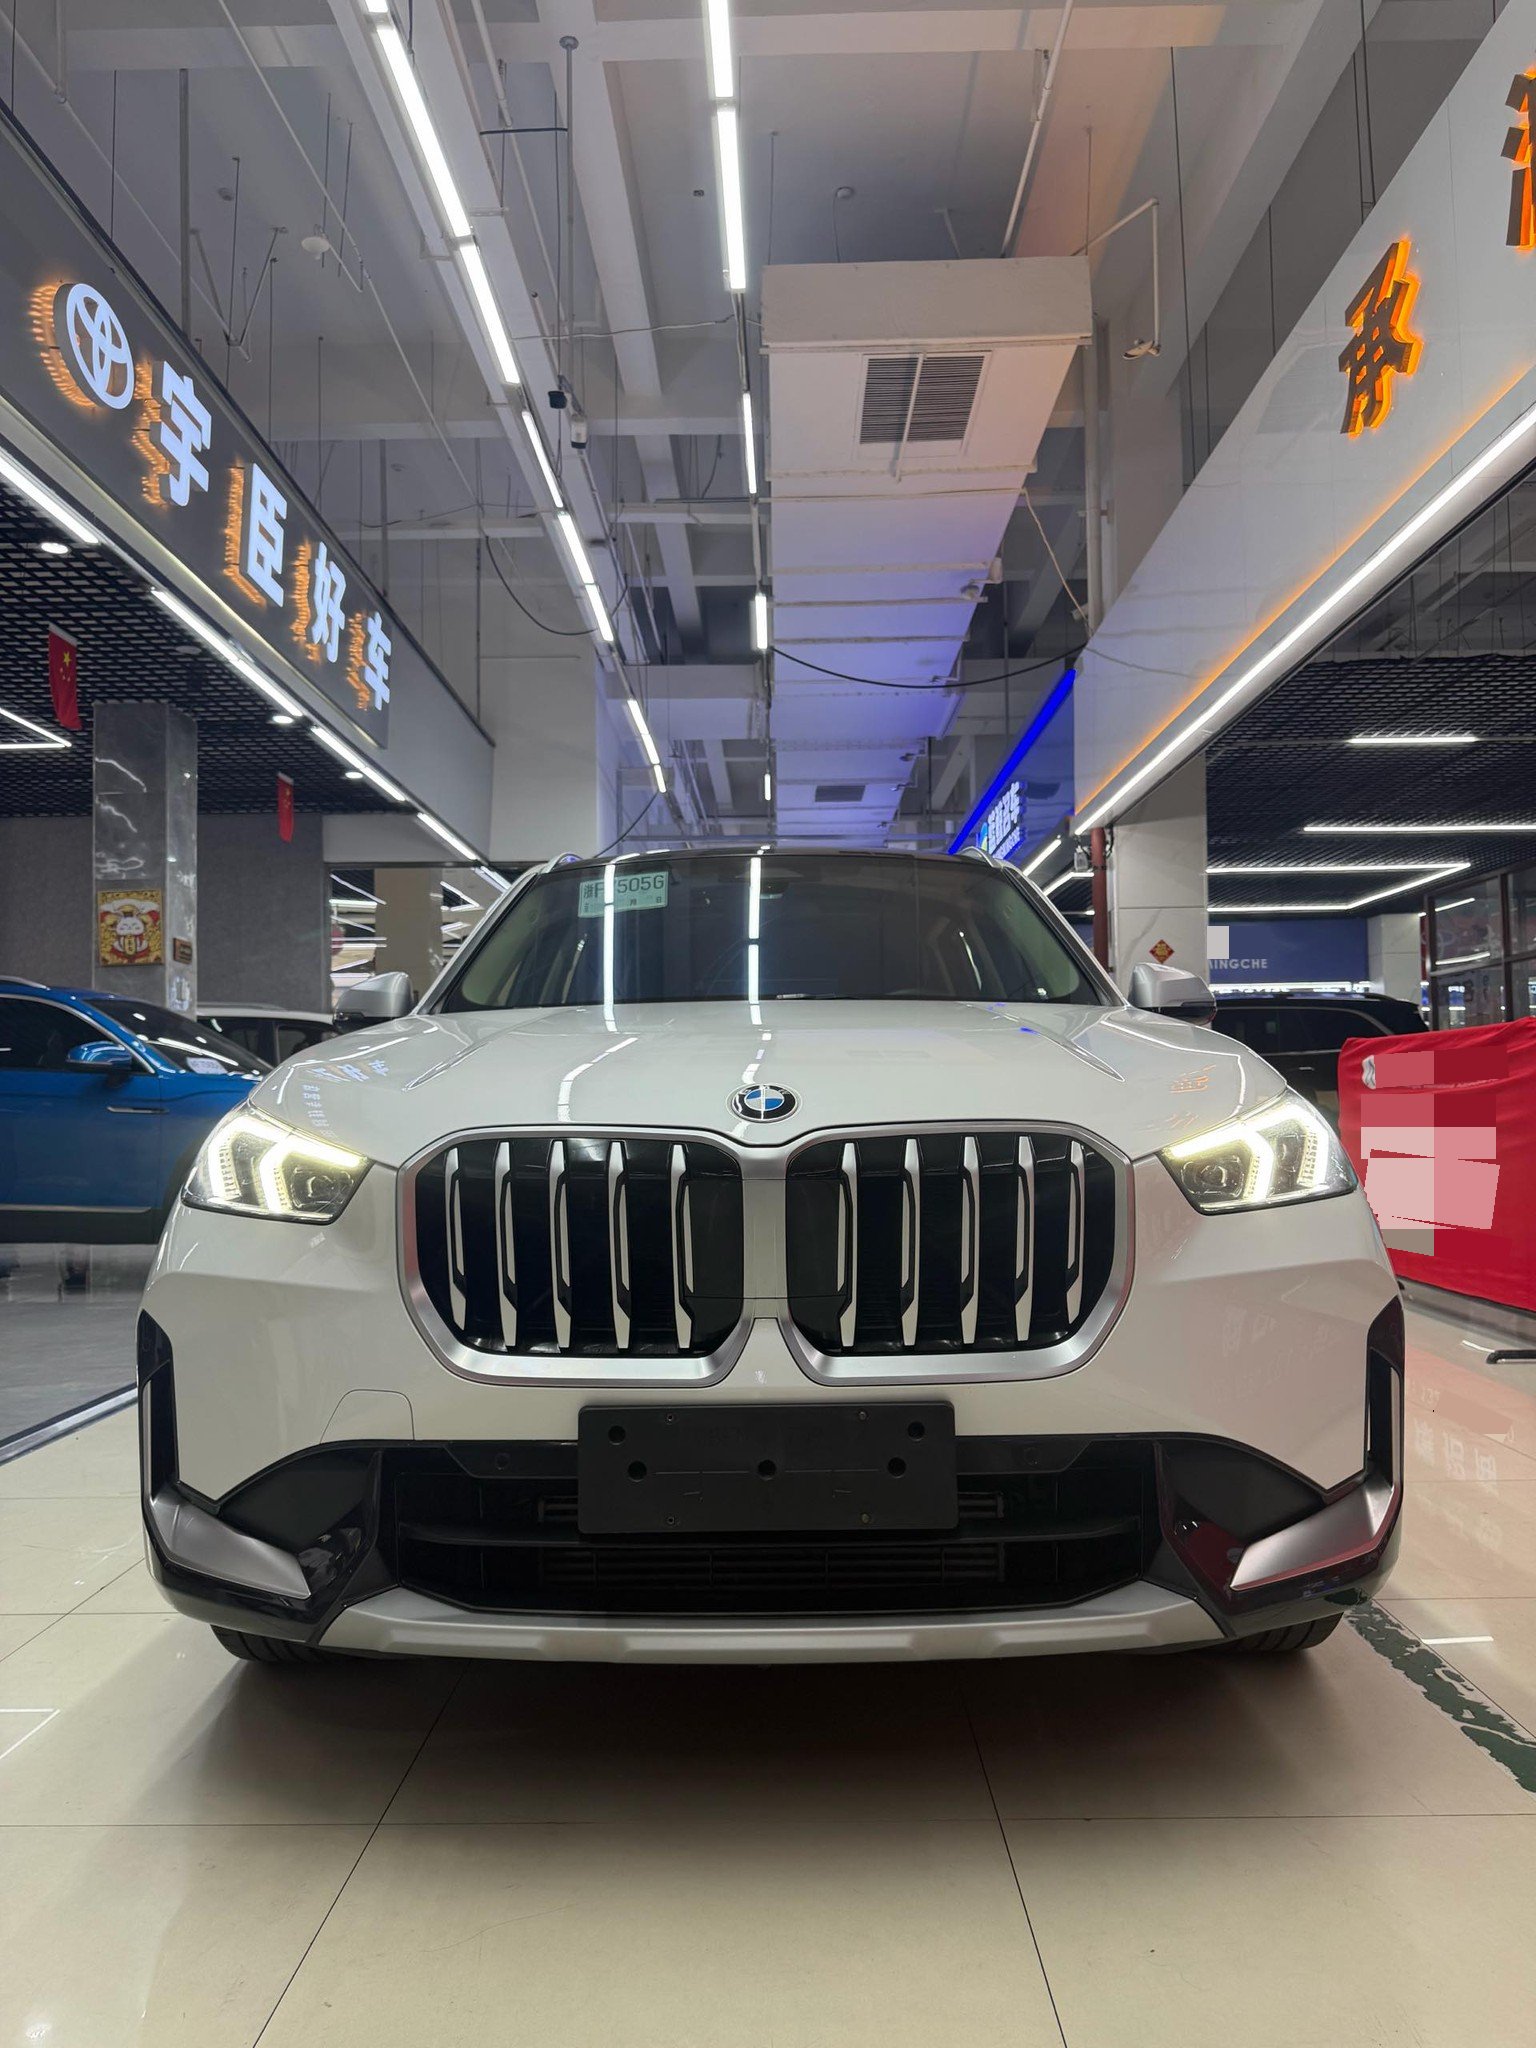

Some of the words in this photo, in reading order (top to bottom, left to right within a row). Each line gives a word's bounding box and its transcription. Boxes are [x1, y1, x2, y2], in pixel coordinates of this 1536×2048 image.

[151, 360, 392, 711] 宇臣好车
[583, 875, 664, 898] 浙F505G
